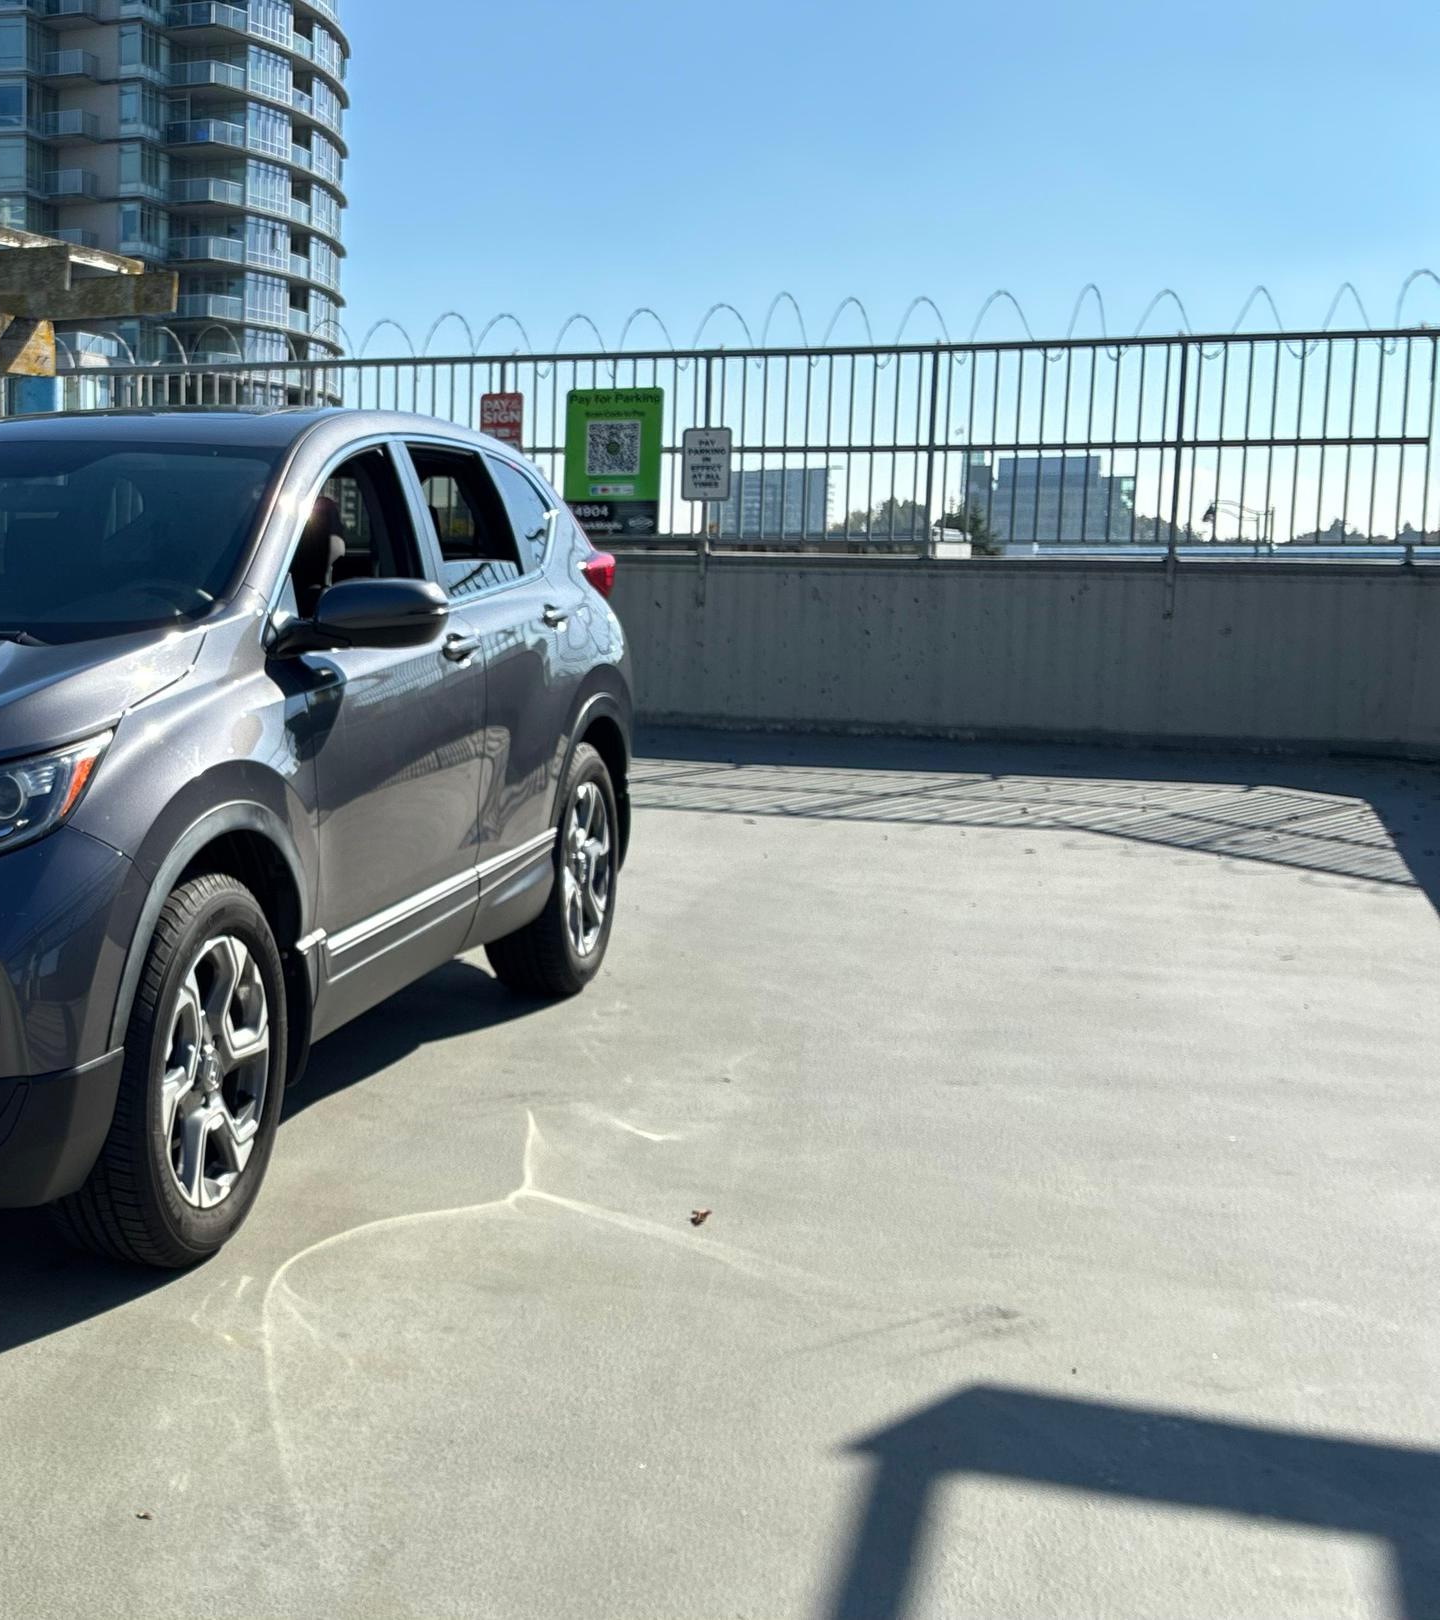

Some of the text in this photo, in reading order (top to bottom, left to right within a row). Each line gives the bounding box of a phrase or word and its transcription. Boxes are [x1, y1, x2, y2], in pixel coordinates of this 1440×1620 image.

[484, 400, 509, 411] PAY
[569, 393, 590, 406] Pay
[595, 393, 612, 404] for
[484, 411, 520, 423] SIGN
